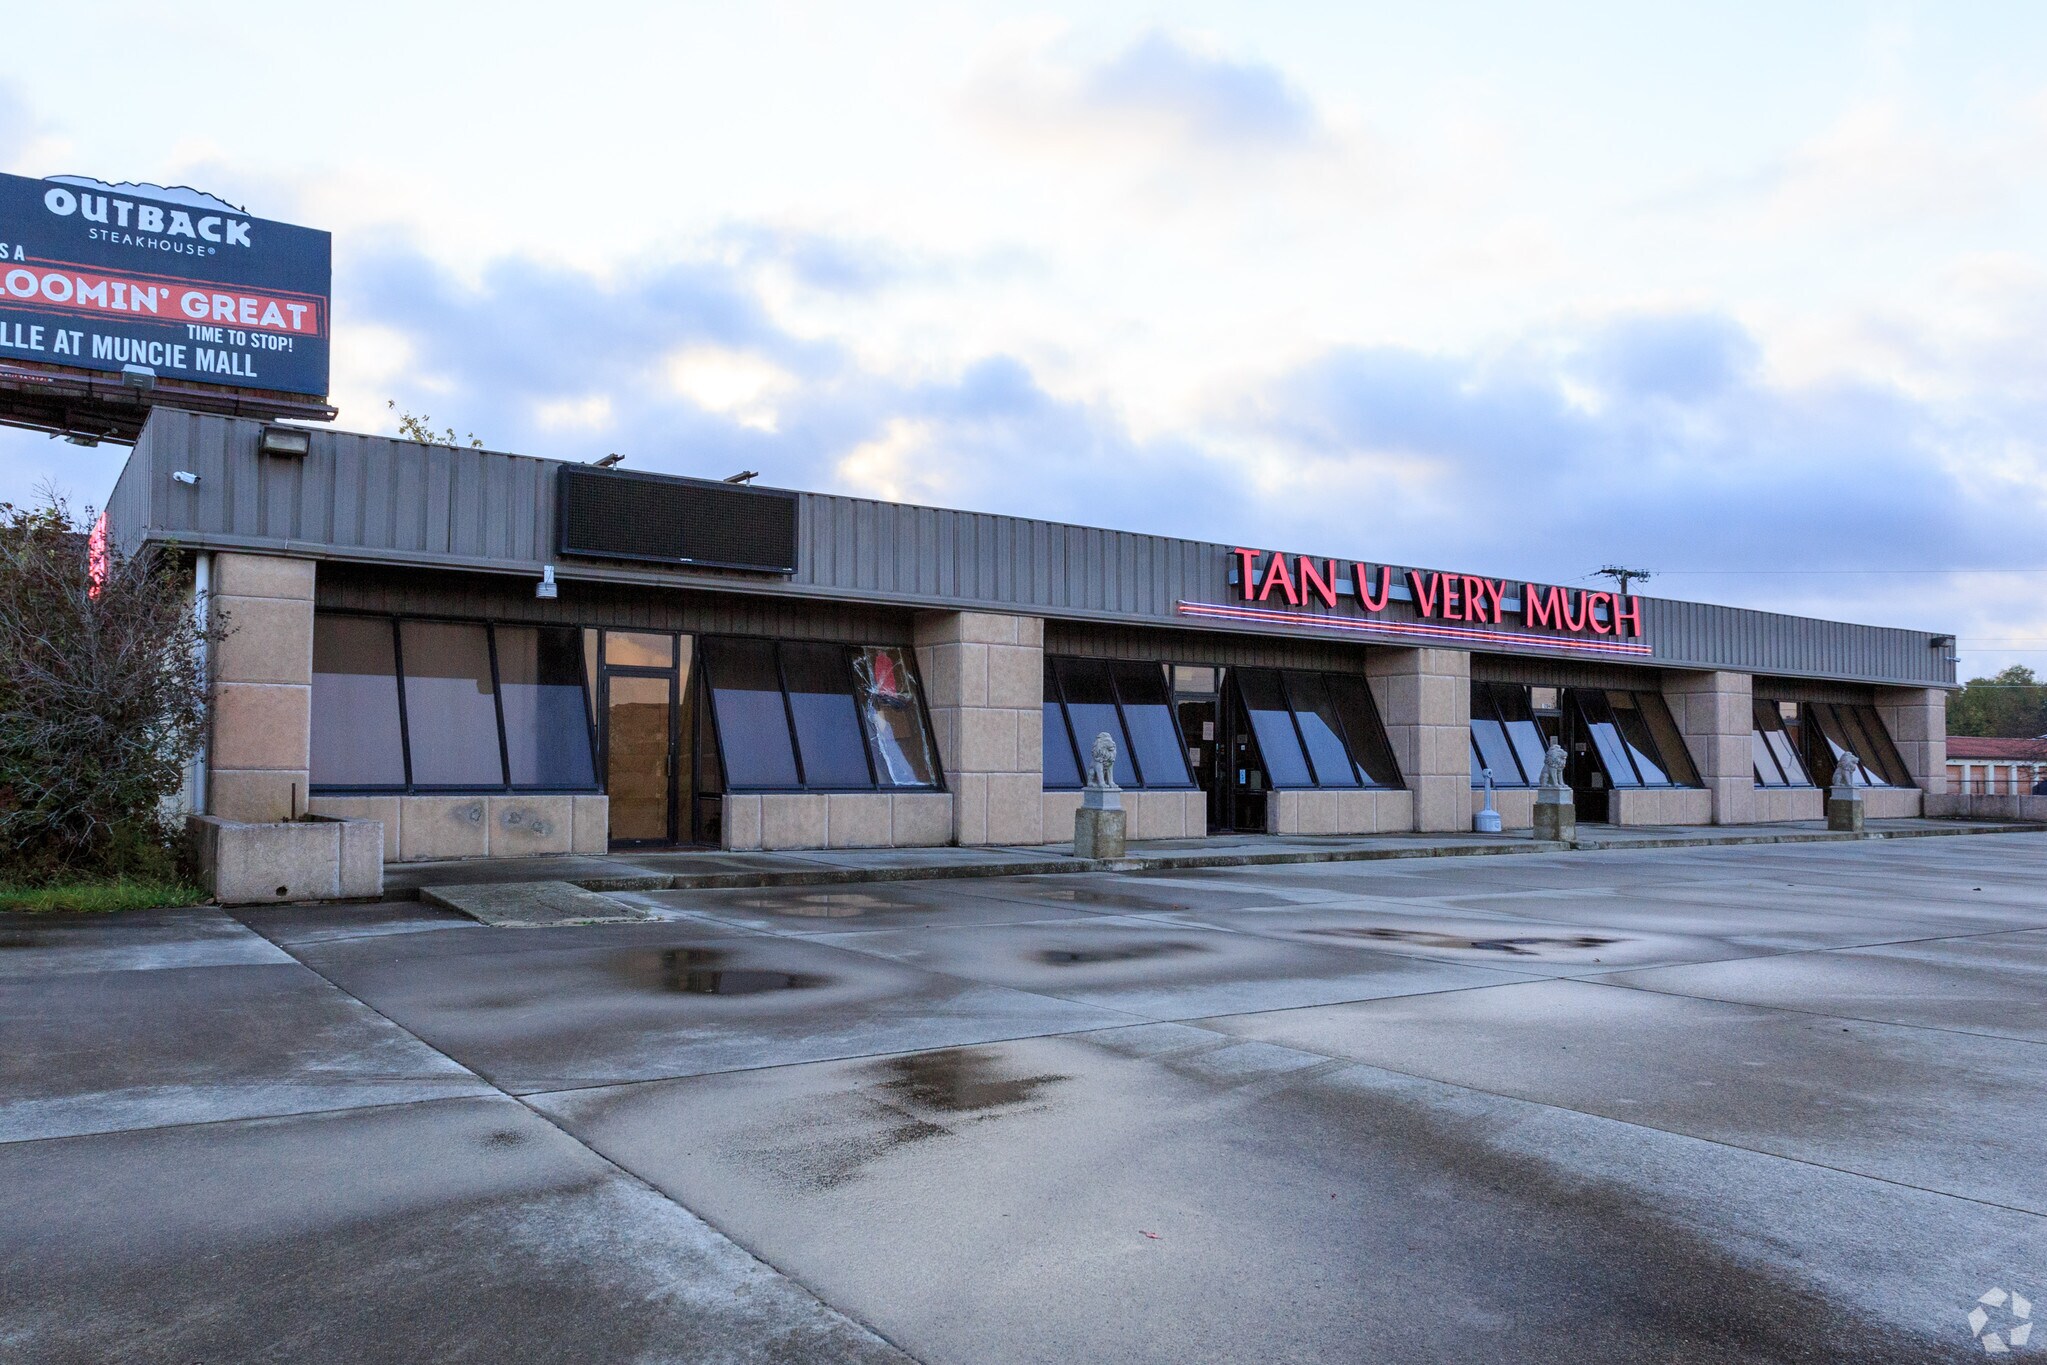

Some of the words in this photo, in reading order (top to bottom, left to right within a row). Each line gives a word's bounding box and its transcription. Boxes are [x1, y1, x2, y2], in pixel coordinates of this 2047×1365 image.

[44, 188, 251, 248] OUTBACK
[14, 244, 25, 261] A
[0, 269, 170, 313] OOMIN'
[181, 291, 308, 330] GREAT
[53, 328, 84, 356] AT
[92, 334, 187, 369] MUNCIE
[196, 347, 257, 377] MALL
[187, 324, 224, 343] TIME
[227, 329, 246, 346] TO
[251, 332, 293, 352] STOP!
[1233, 547, 1337, 609] TAN
[1351, 562, 1391, 612] U
[1405, 569, 1506, 625] VERY
[1520, 583, 1641, 637] MUCH
